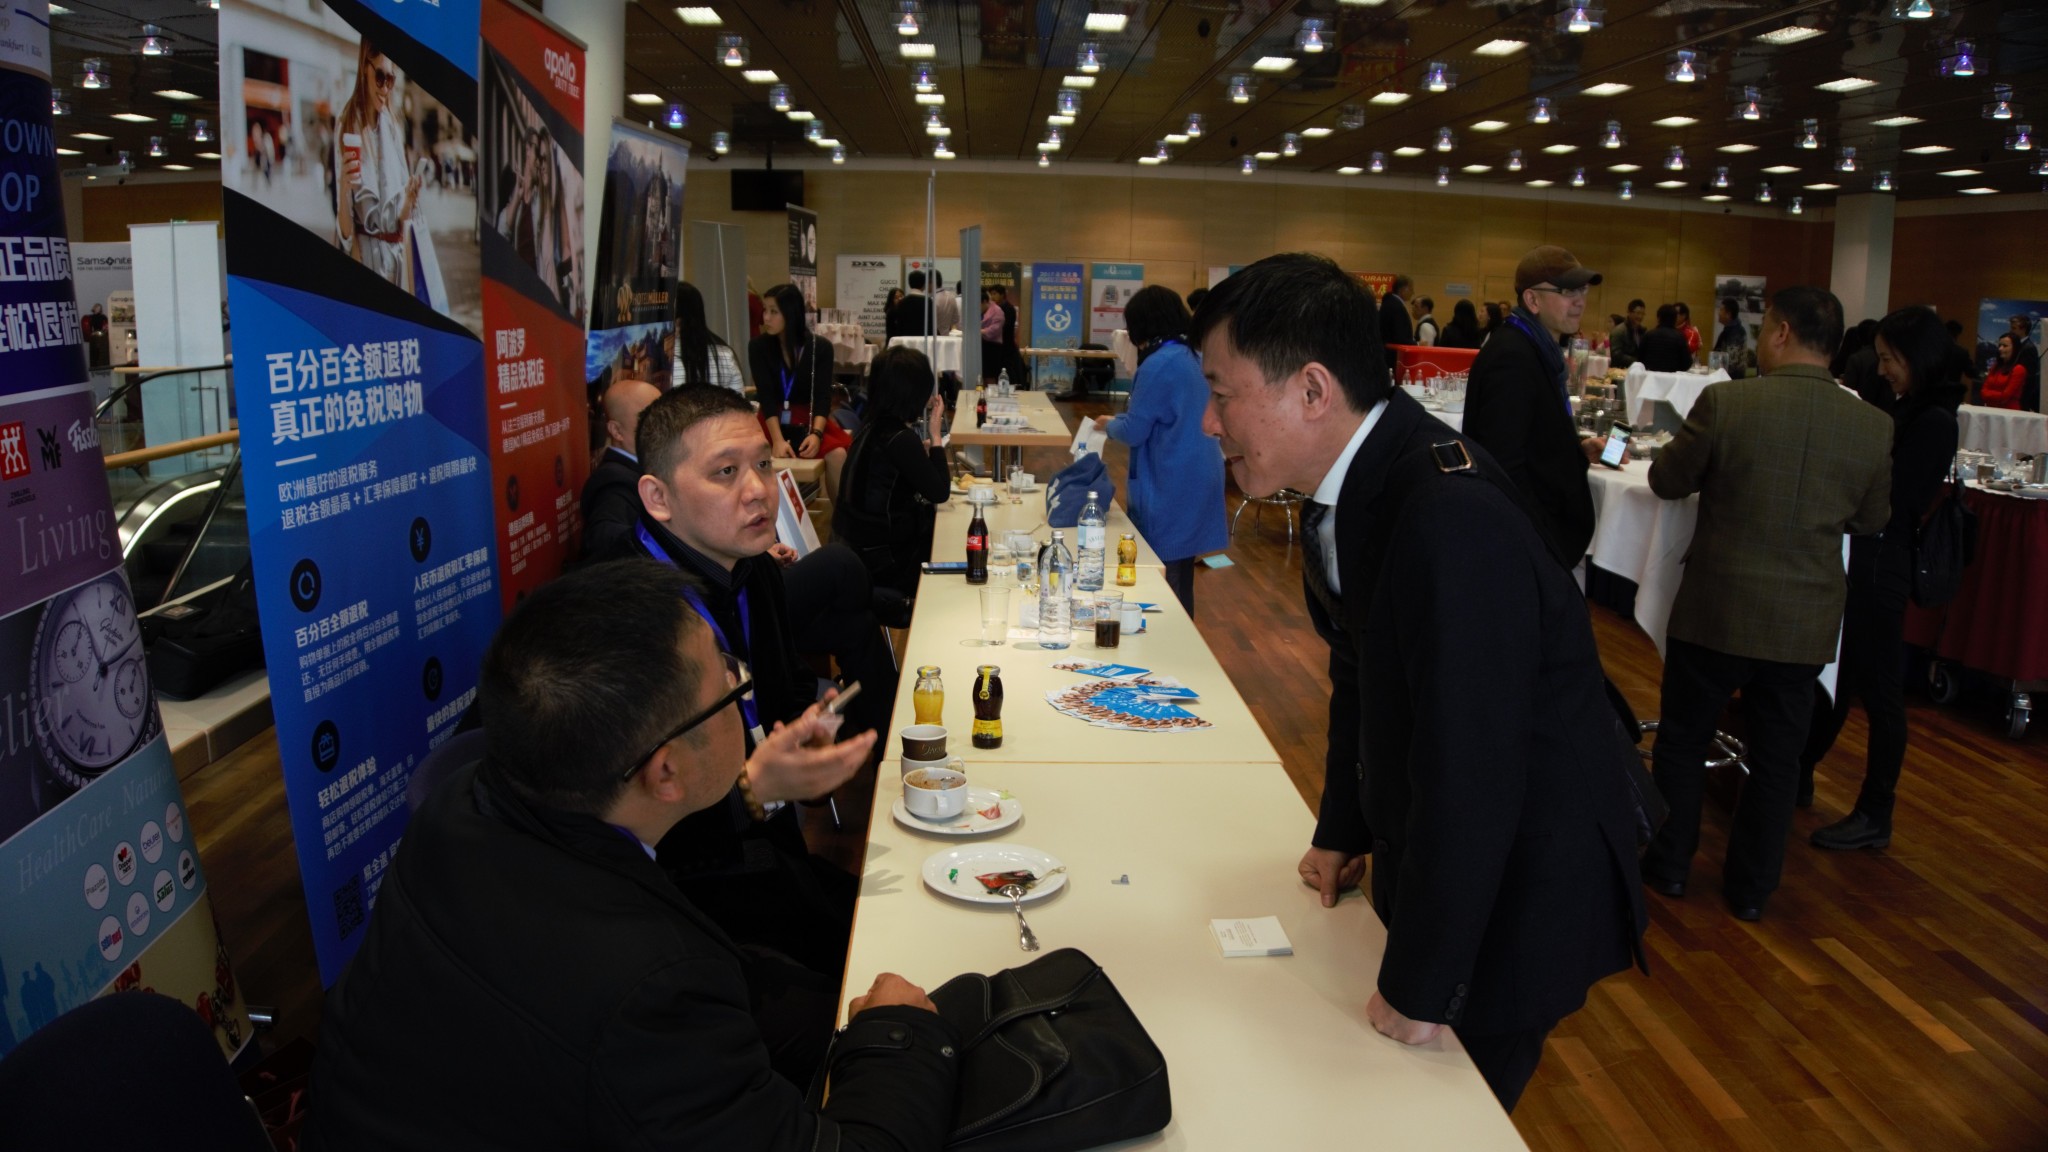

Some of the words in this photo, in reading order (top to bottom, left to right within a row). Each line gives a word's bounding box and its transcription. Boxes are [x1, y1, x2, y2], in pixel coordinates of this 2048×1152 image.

[544, 47, 577, 83] apollo
[568, 83, 580, 98] FREE
[0, 119, 55, 159] OWN
[77, 256, 132, 266] Samsonite
[851, 260, 886, 268] DIVA
[495, 327, 526, 360] 阿波罗
[265, 338, 422, 395] 百分百全额退税
[497, 357, 544, 394] 精品免税店
[269, 380, 424, 446] 真正的免税购物
[37, 424, 62, 471] WMF
[278, 459, 379, 503] 欧洲最好的退税服务
[281, 491, 351, 530] 退税金额最高
[363, 472, 417, 505] 汇率保障最好
[429, 455, 478, 485] 退税周期最快
[17, 504, 111, 575] Living
[295, 599, 369, 648] 百分百全额退税
[317, 755, 377, 810] 轻松退税体验
[18, 803, 113, 895] HealthCare
[142, 831, 161, 850] beurer
[157, 880, 174, 904] Salus
